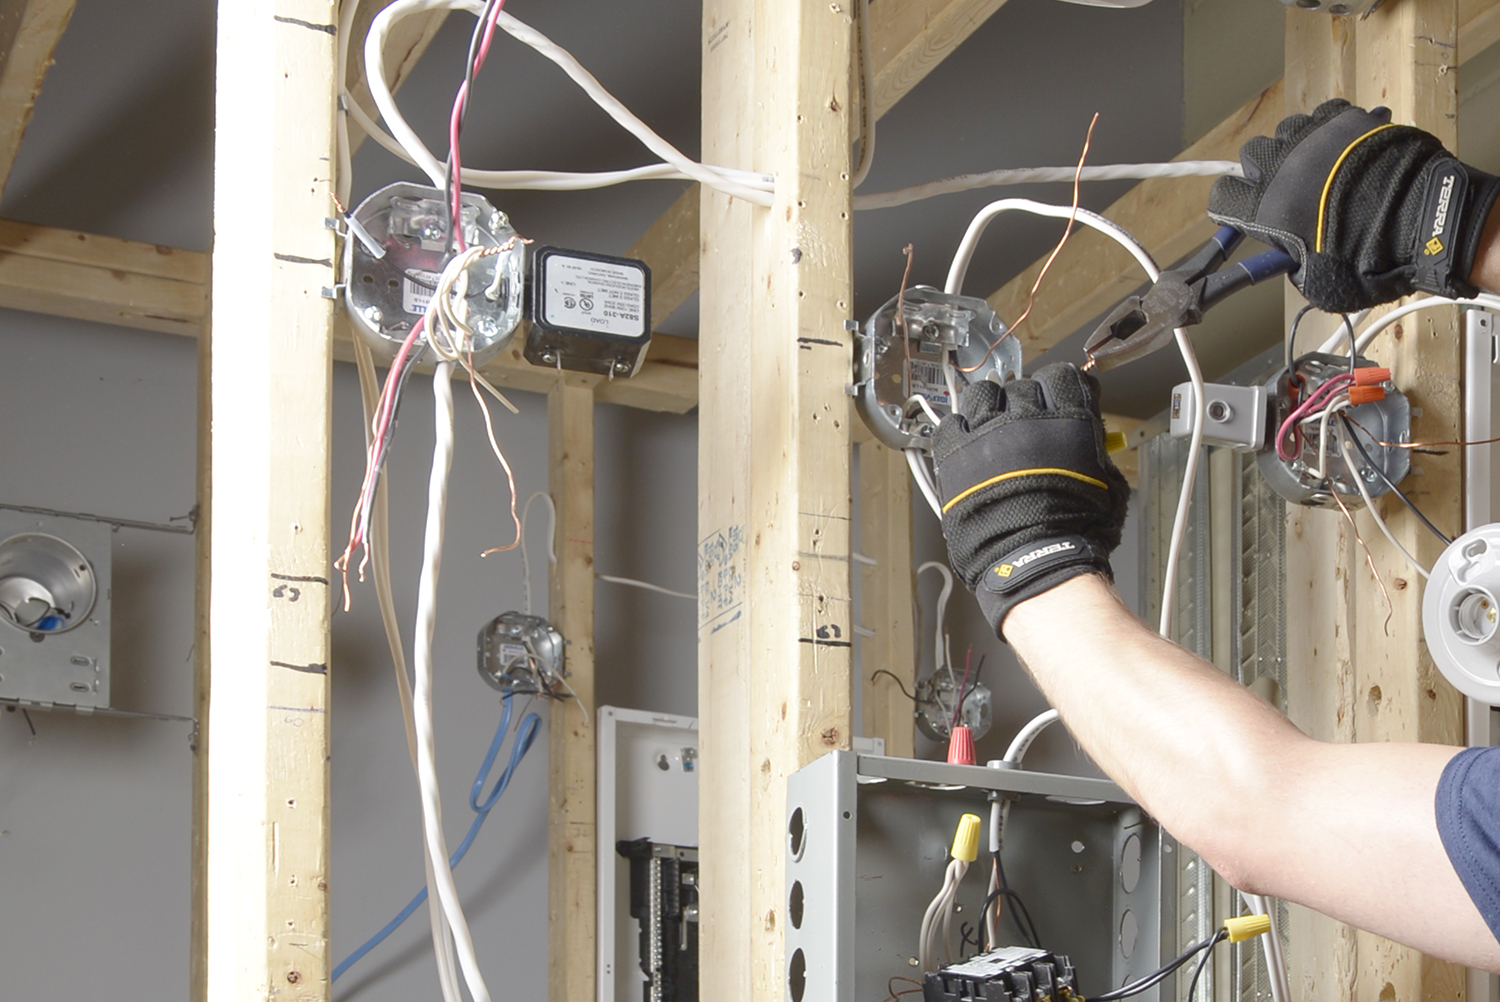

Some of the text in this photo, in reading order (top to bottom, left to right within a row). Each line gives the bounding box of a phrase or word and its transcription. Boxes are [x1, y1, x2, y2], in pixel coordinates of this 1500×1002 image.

[1432, 175, 1455, 237] TERRA
[590, 317, 609, 325] LOAD
[603, 310, 640, 321] S82A-310
[1011, 541, 1076, 568] TERRA
